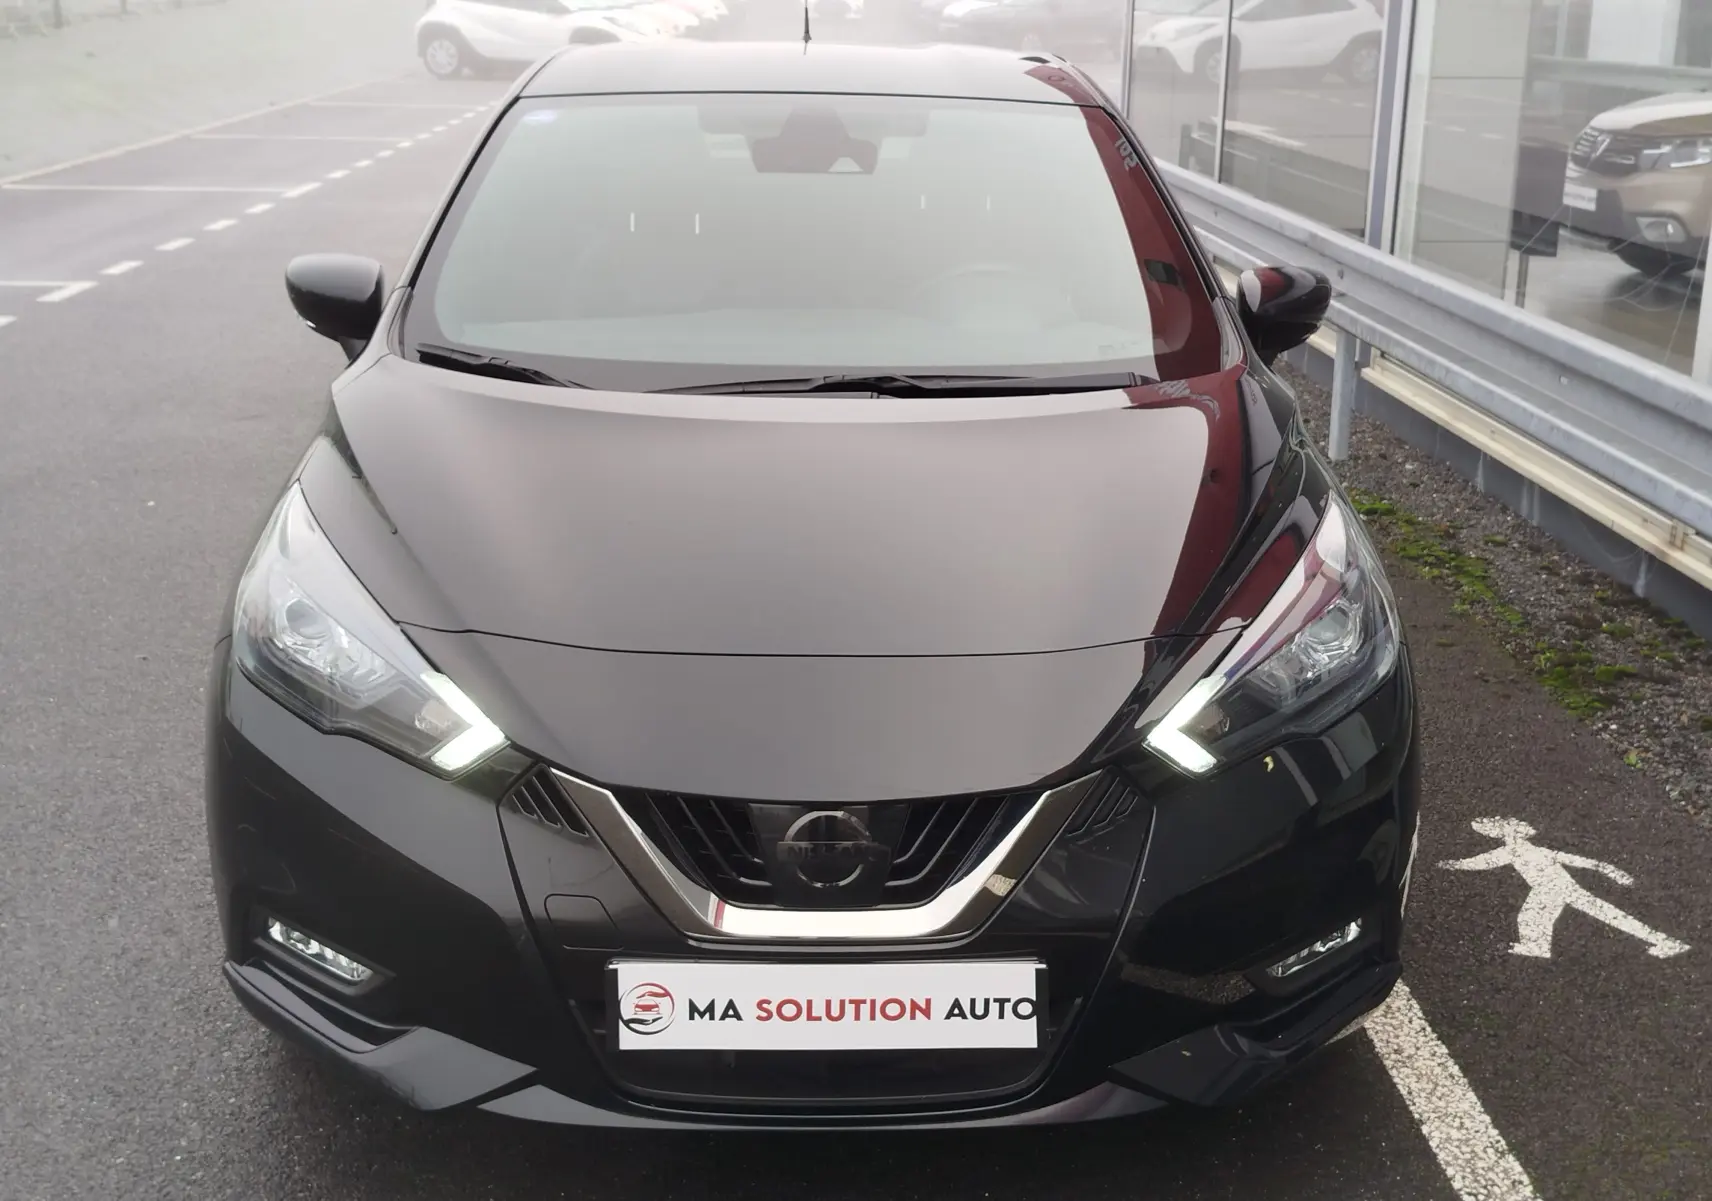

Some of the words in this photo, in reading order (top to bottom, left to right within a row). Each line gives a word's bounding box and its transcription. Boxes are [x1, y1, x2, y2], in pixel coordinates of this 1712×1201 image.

[688, 998, 744, 1022] MA
[755, 998, 932, 1022] SOLUTION
[944, 997, 1038, 1021] AUTO
